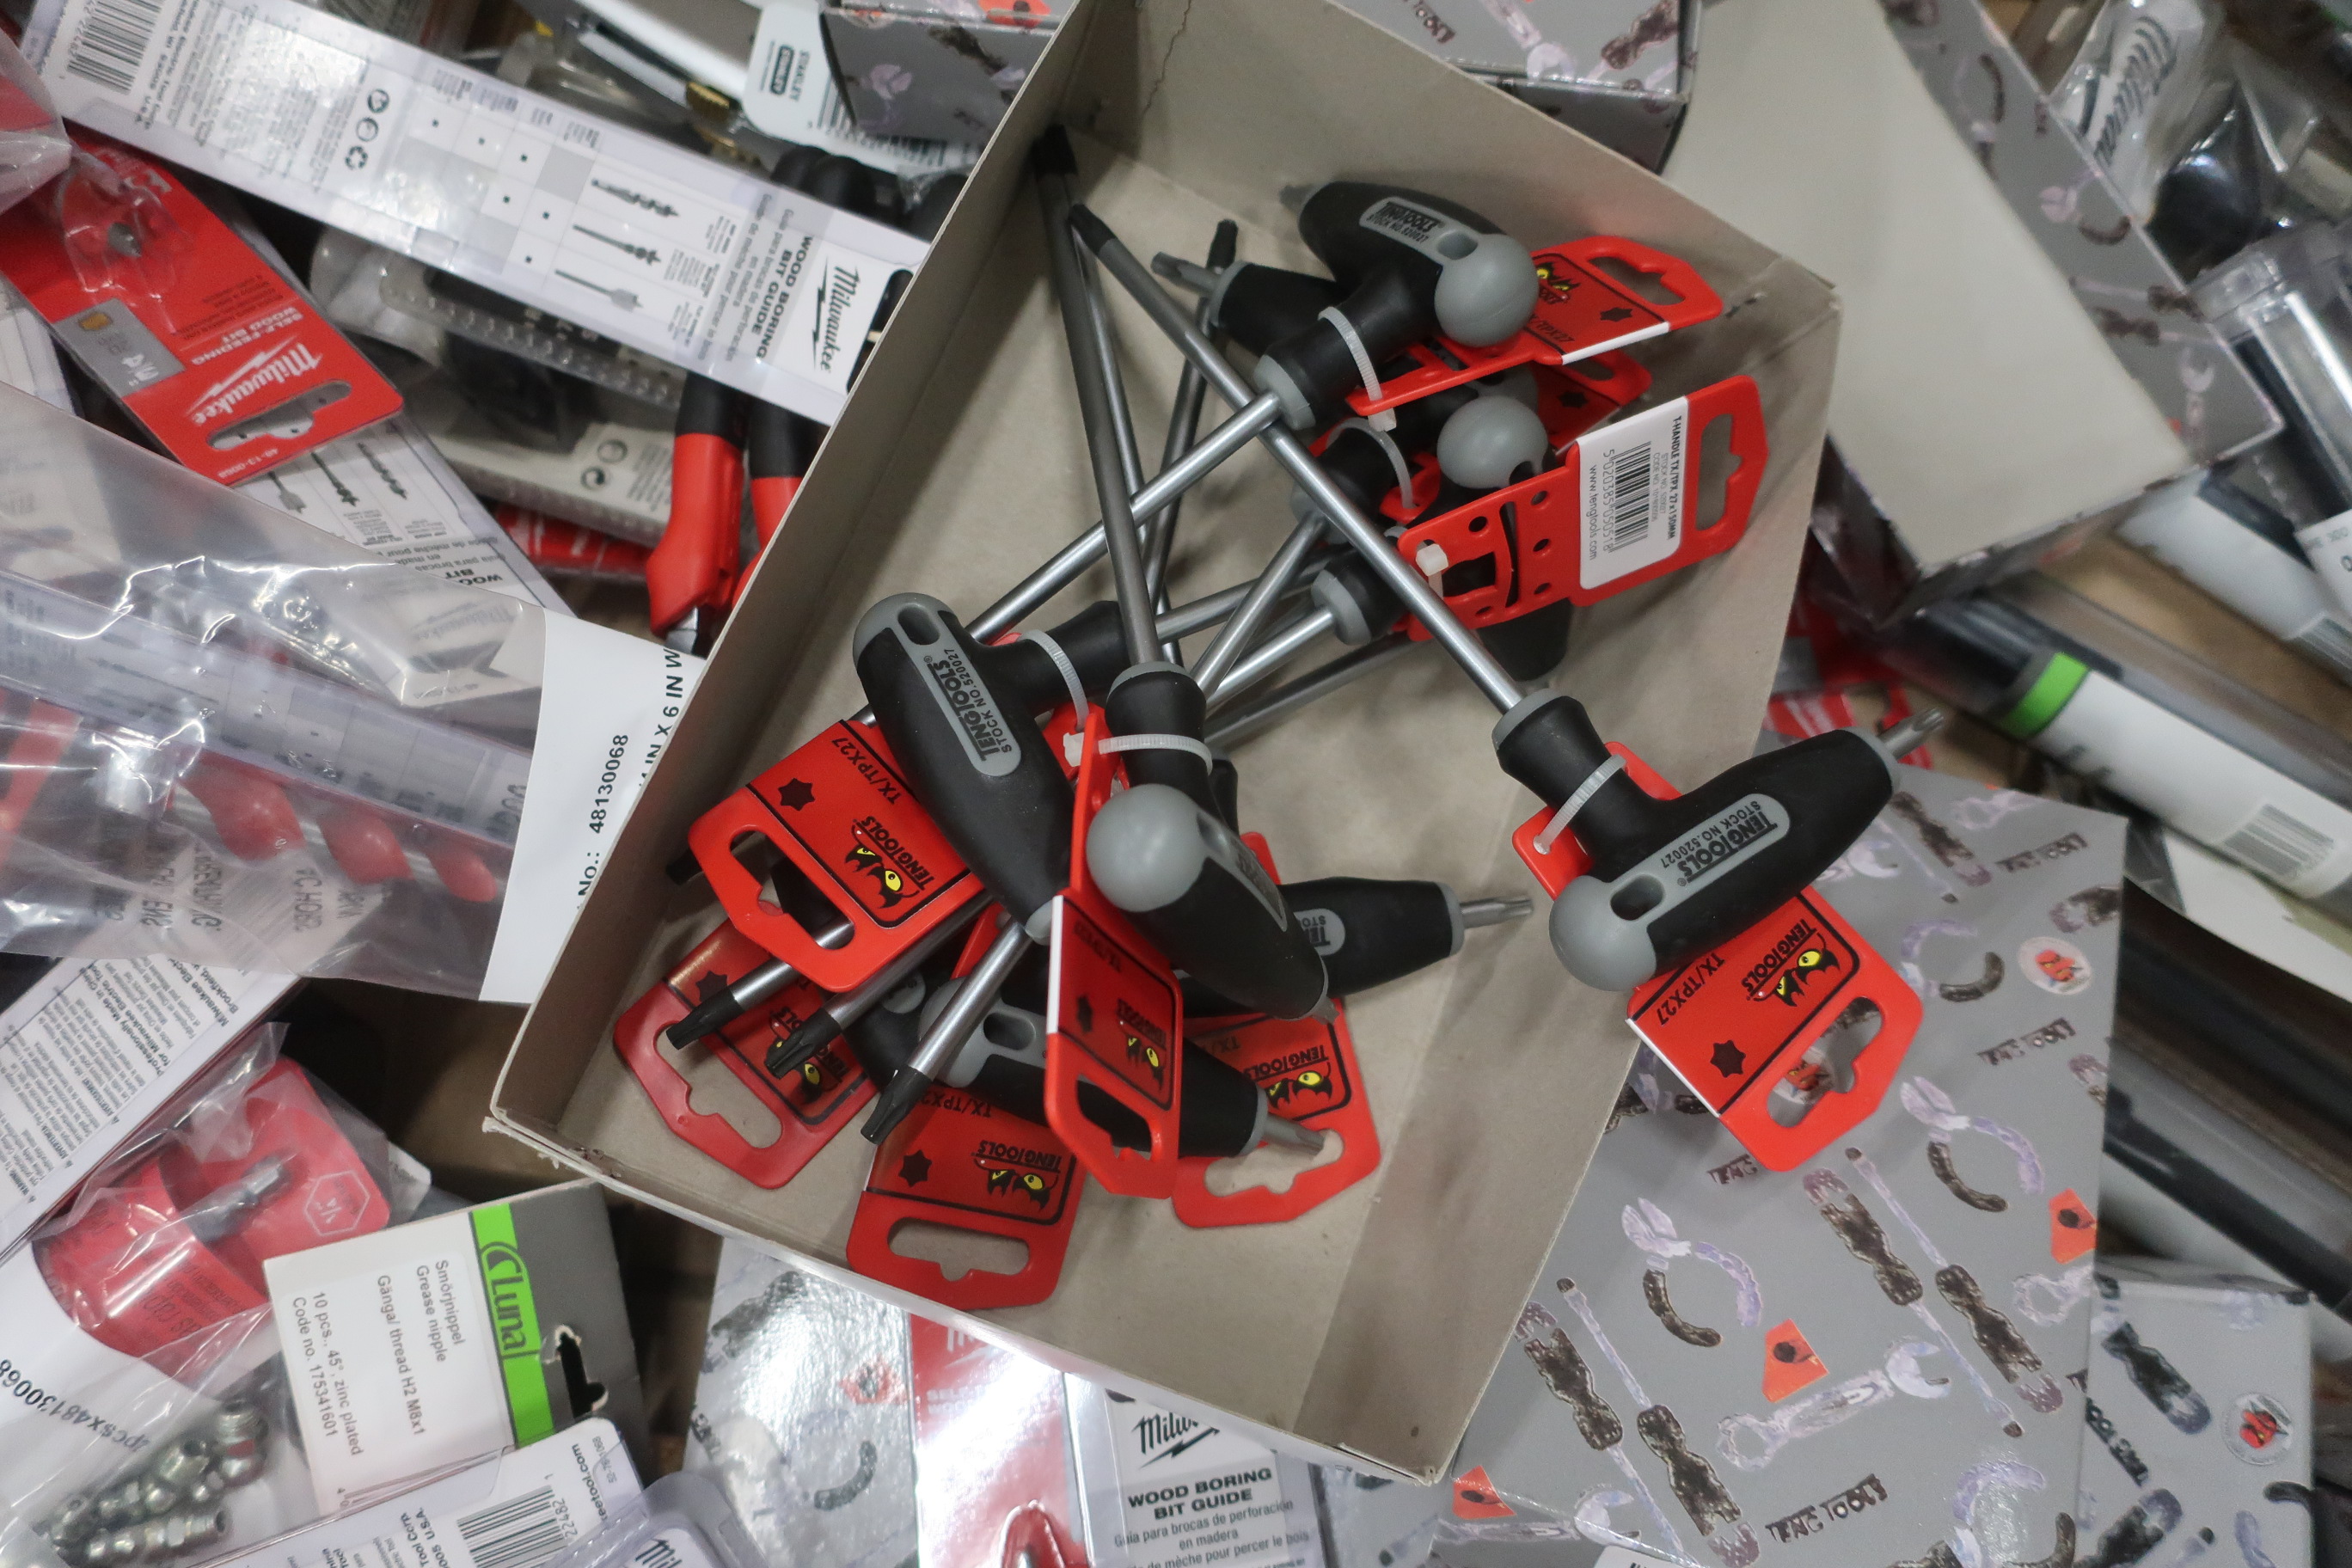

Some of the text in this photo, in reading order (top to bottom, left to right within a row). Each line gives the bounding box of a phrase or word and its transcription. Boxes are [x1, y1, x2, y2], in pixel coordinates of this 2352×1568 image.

[752, 250, 793, 334] BIT GUIDE
[756, 236, 813, 358] WOOD BORING
[812, 266, 860, 370] Milwaukee
[193, 344, 321, 424] Milwaukee
[1650, 452, 1663, 474] CODE
[1657, 452, 1669, 476] STOCK
[1671, 416, 1687, 459] T-HANDLE
[1665, 460, 1680, 493] TX/TPX
[1580, 465, 1607, 560] www.tengtools.com
[654, 724, 672, 737] X
[665, 676, 683, 699] IN
[931, 657, 989, 762] TENGTOOLS
[944, 649, 1013, 753] STOCK NO.520027
[589, 735, 628, 834] 48130068
[832, 738, 903, 805] TX/TPX27
[854, 817, 934, 893] TENGTOOLS
[1661, 801, 1761, 868] STOCK NO.520027
[1677, 812, 1778, 882] TENGTOOLS
[1301, 914, 1326, 928] STO
[78, 967, 97, 991] China
[1657, 952, 1725, 1026] TX/TPX27
[1739, 921, 1816, 996] TENGTOOLS
[87, 962, 170, 1067] for Milwaukee Electric Tool
[103, 998, 121, 1022] Made
[120, 1019, 165, 1077] Professionally
[916, 1089, 992, 1118] TX/TPX2
[974, 1139, 1063, 1173] TENGTOOLS
[313, 1292, 328, 1309] 10
[416, 1265, 448, 1363] Grease nipple
[435, 1260, 466, 1345] Smörjnippel
[492, 1277, 526, 1351] Luna
[292, 1297, 338, 1436] Code no. 175341601
[377, 1275, 426, 1435] Gänga/ thread H2 M8x1
[334, 1380, 350, 1409] zinc
[340, 1412, 364, 1456] plated
[1128, 1468, 1272, 1508] WOOD BORING
[1155, 1489, 1253, 1521] BIT GUIDE
[1142, 1528, 1169, 1543] para
[1171, 1518, 1210, 1535] brocas
[1212, 1513, 1227, 1526] de
[1229, 1498, 1295, 1524] perforación
[1179, 1529, 1240, 1552] en madera
[1205, 1547, 1230, 1565] pour
[1234, 1540, 1270, 1559] percer
[1286, 1532, 1310, 1547] bois
[413, 1543, 429, 1568] Tool
